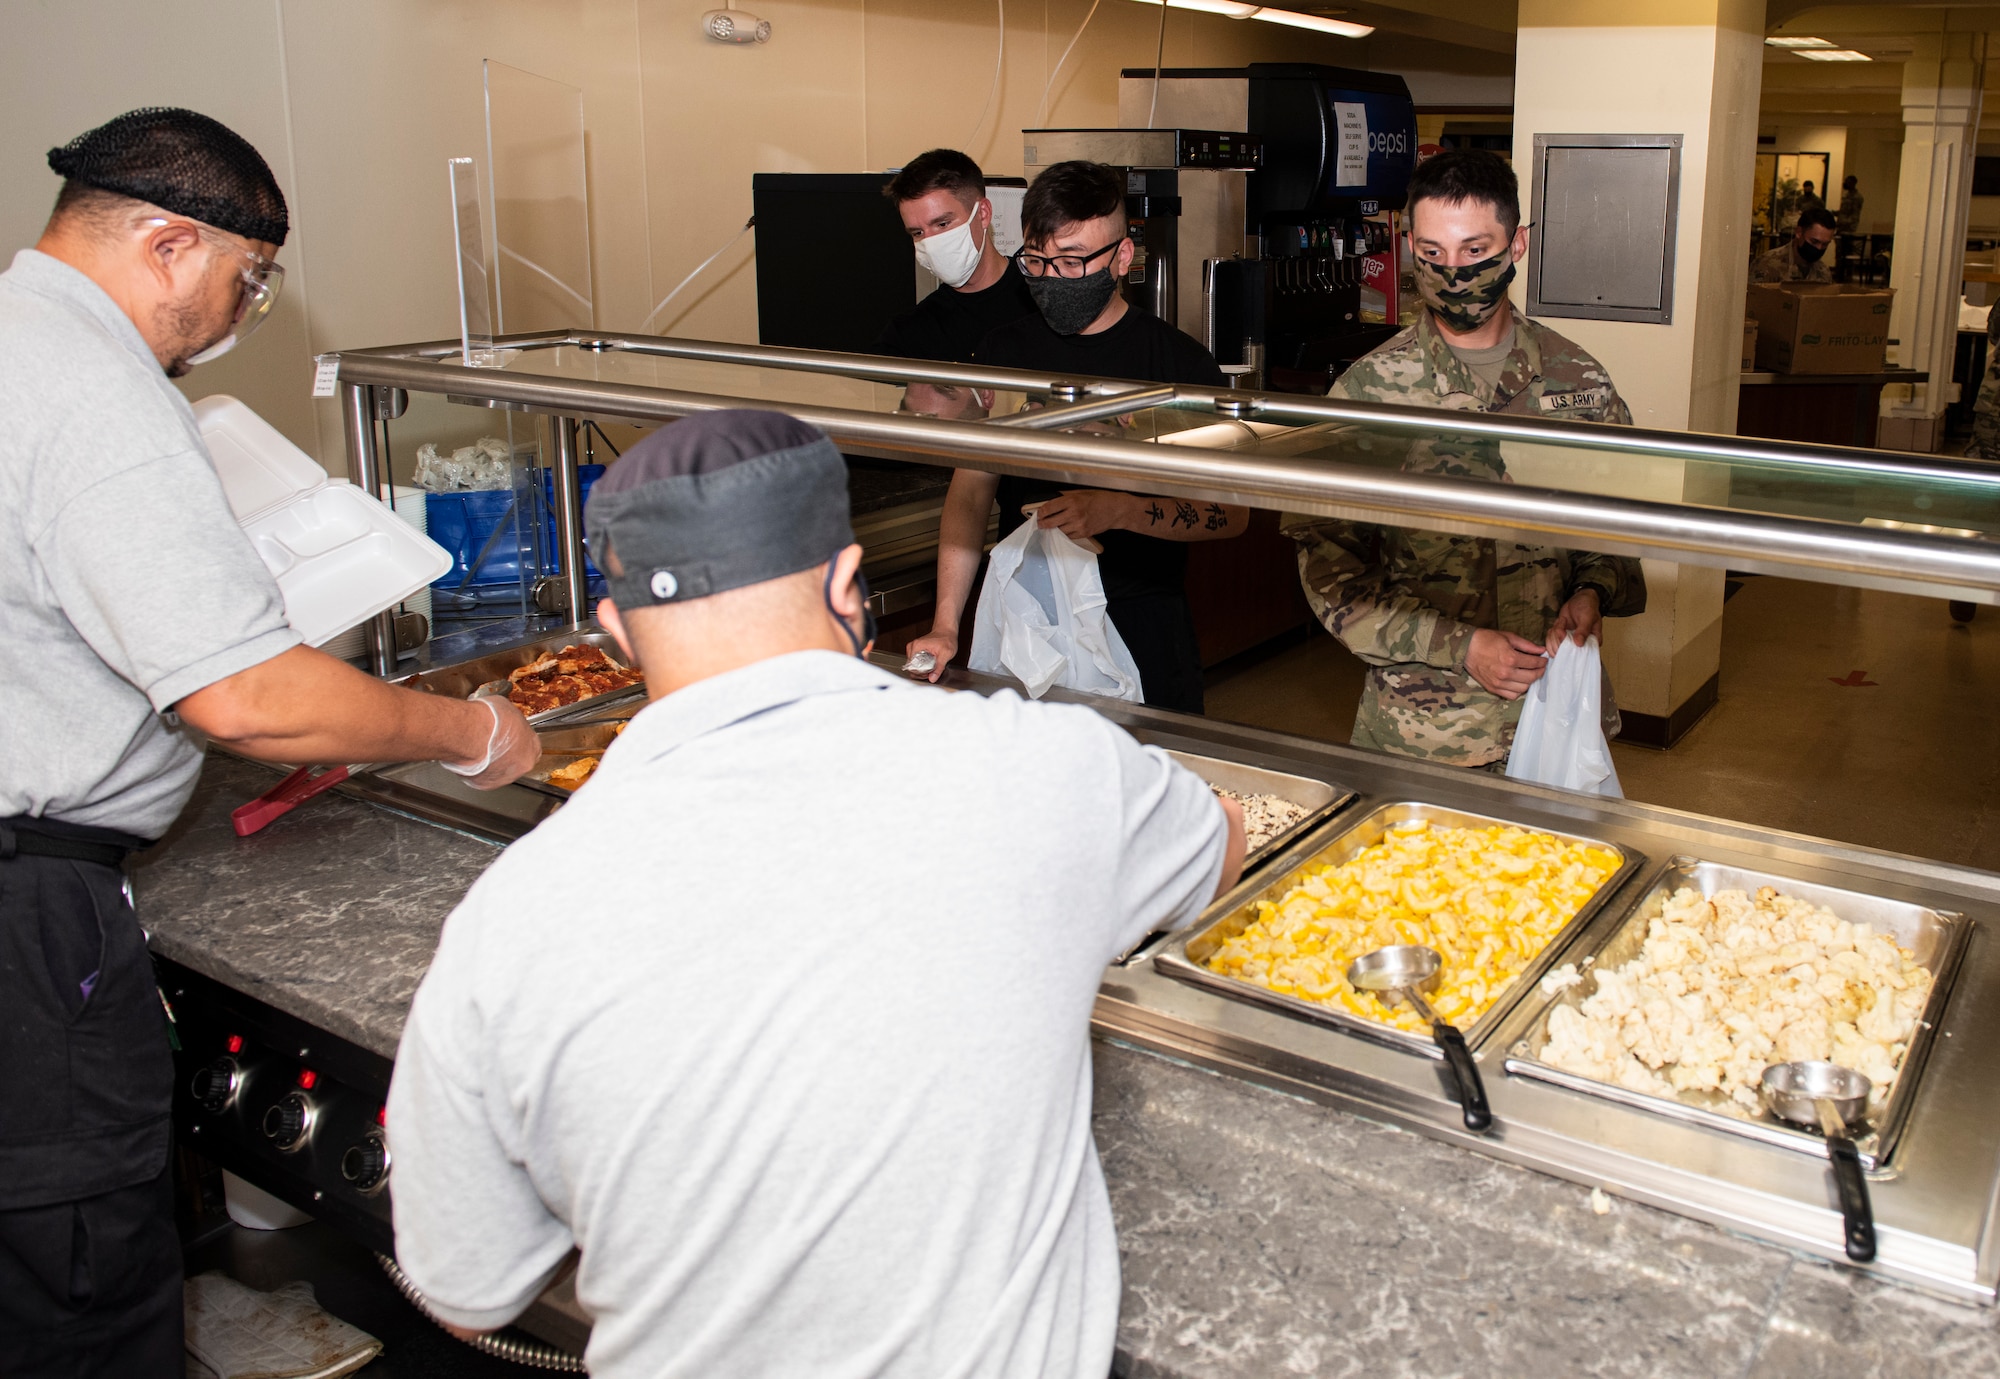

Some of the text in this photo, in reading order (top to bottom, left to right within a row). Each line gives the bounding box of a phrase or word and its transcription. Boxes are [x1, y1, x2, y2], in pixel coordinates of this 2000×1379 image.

[1368, 129, 1407, 159] pepsi
[1828, 336, 1885, 346] FRITO-LAY
[1551, 394, 1595, 408] U.S. ARMY
